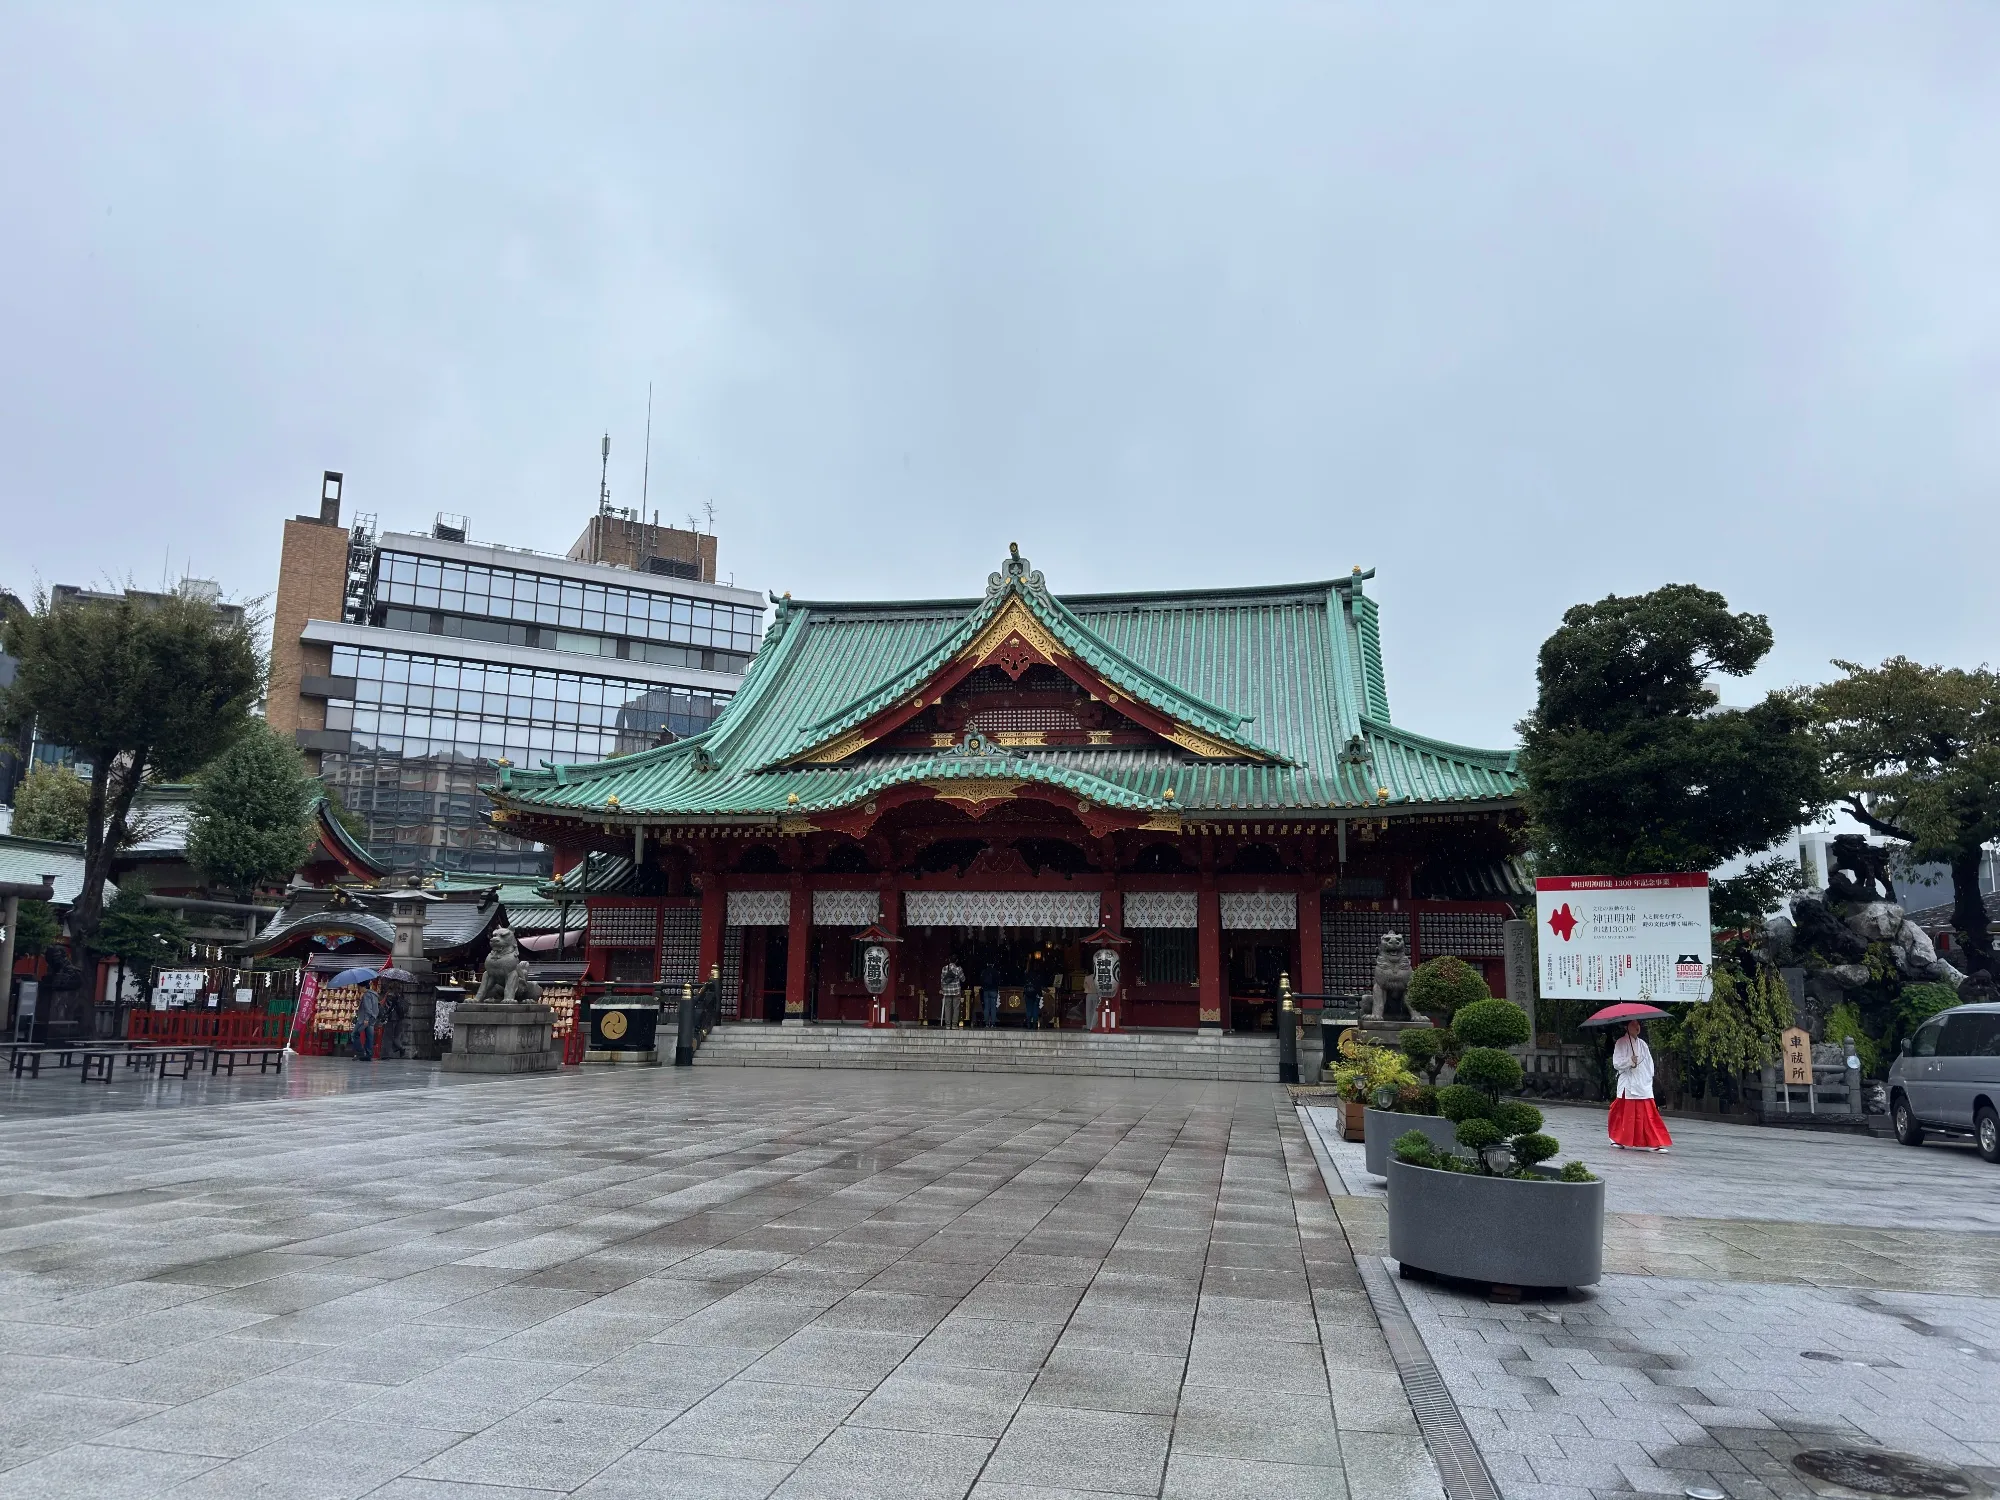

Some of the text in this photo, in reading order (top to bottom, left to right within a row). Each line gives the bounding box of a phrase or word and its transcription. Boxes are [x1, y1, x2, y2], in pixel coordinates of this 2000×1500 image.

[1615, 879, 1632, 887] 1300
[1634, 878, 1670, 887] 年記念事業
[1593, 913, 1636, 924] 神田明神
[867, 955, 882, 986] 神田明神
[1096, 959, 1112, 990] 神田明神
[1790, 1035, 1805, 1081] 車祓所
